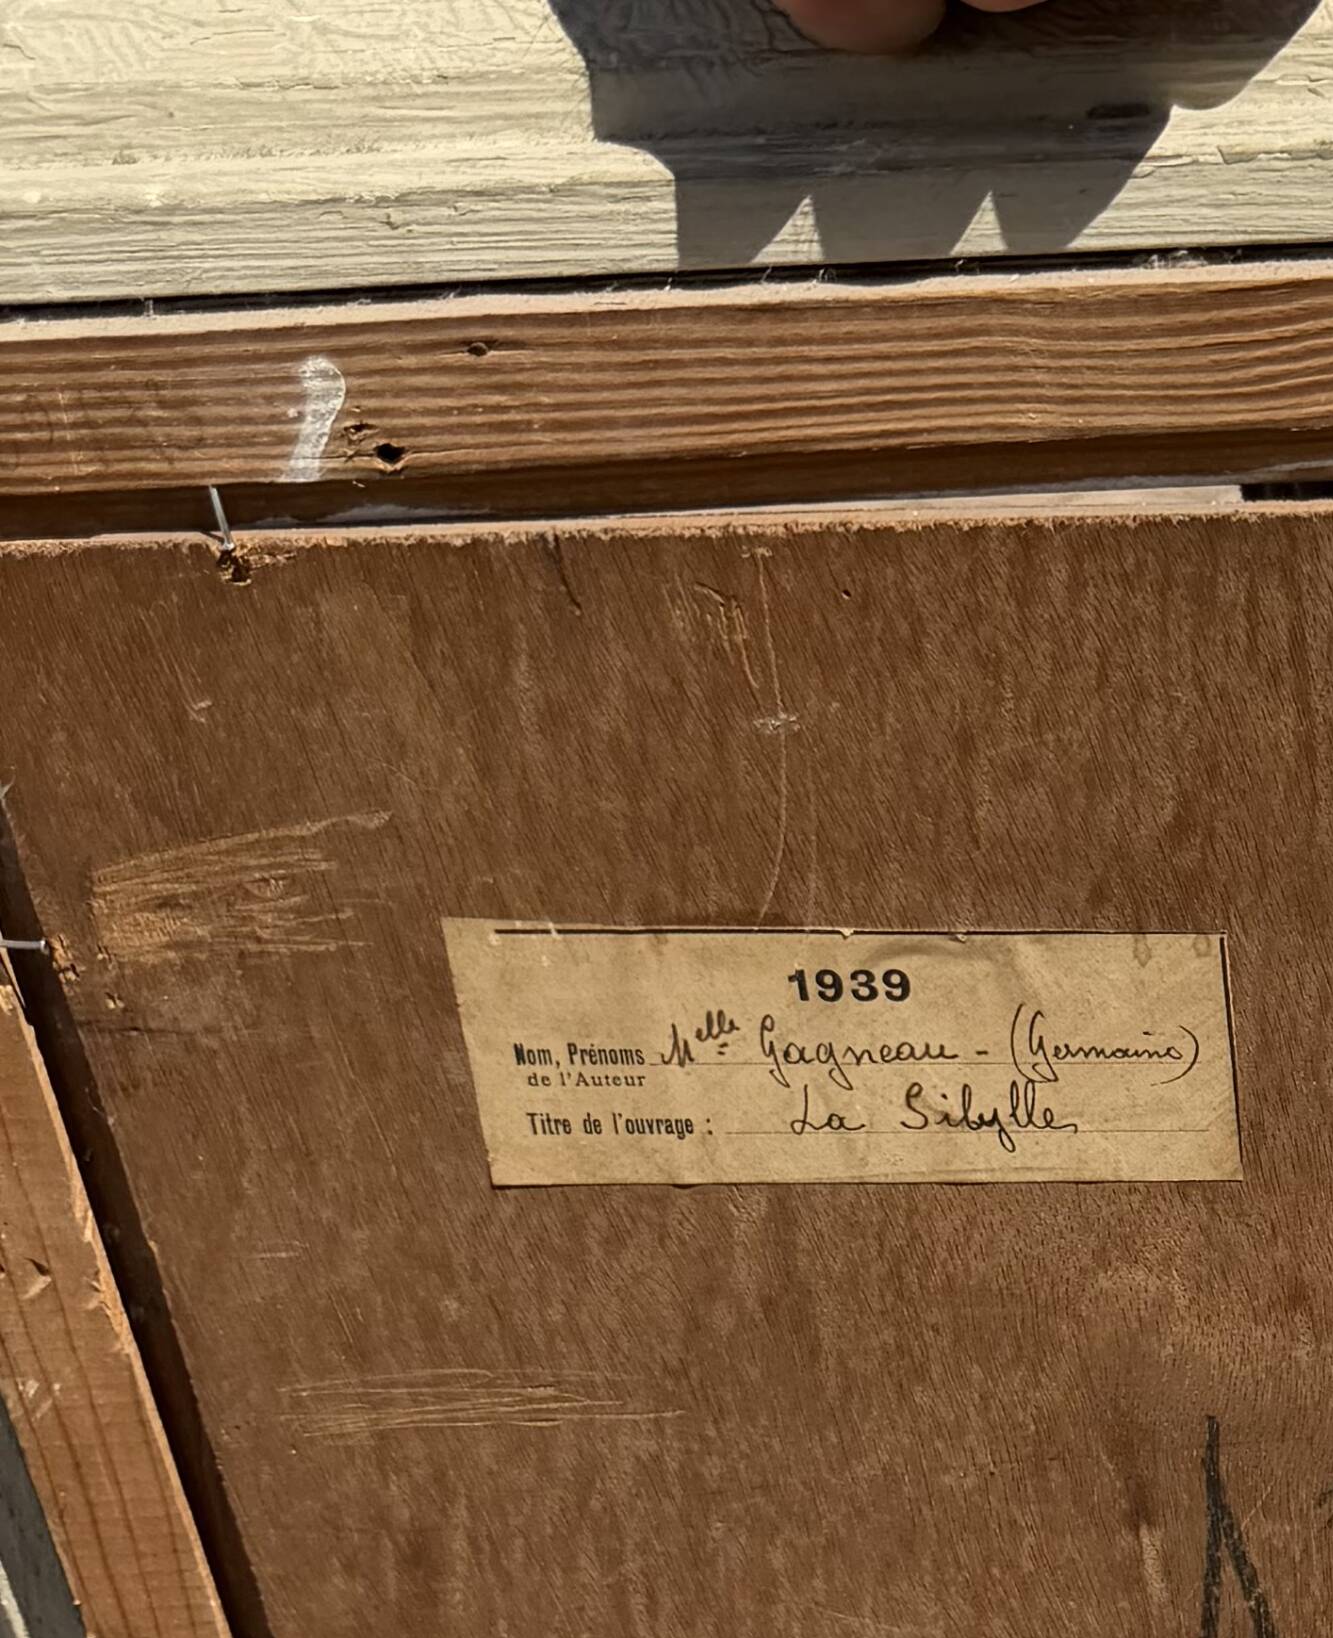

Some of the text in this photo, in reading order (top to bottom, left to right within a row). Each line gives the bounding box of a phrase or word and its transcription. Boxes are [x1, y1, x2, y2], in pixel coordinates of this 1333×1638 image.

[787, 968, 912, 1002] 1939
[513, 1042, 646, 1069] Nom, Prénoms
[527, 1071, 647, 1088] de l'Auteur
[790, 1083, 867, 1135] La
[526, 1112, 573, 1136] Titre
[582, 1112, 603, 1136] de
[612, 1112, 695, 1141] l'ouvrage
